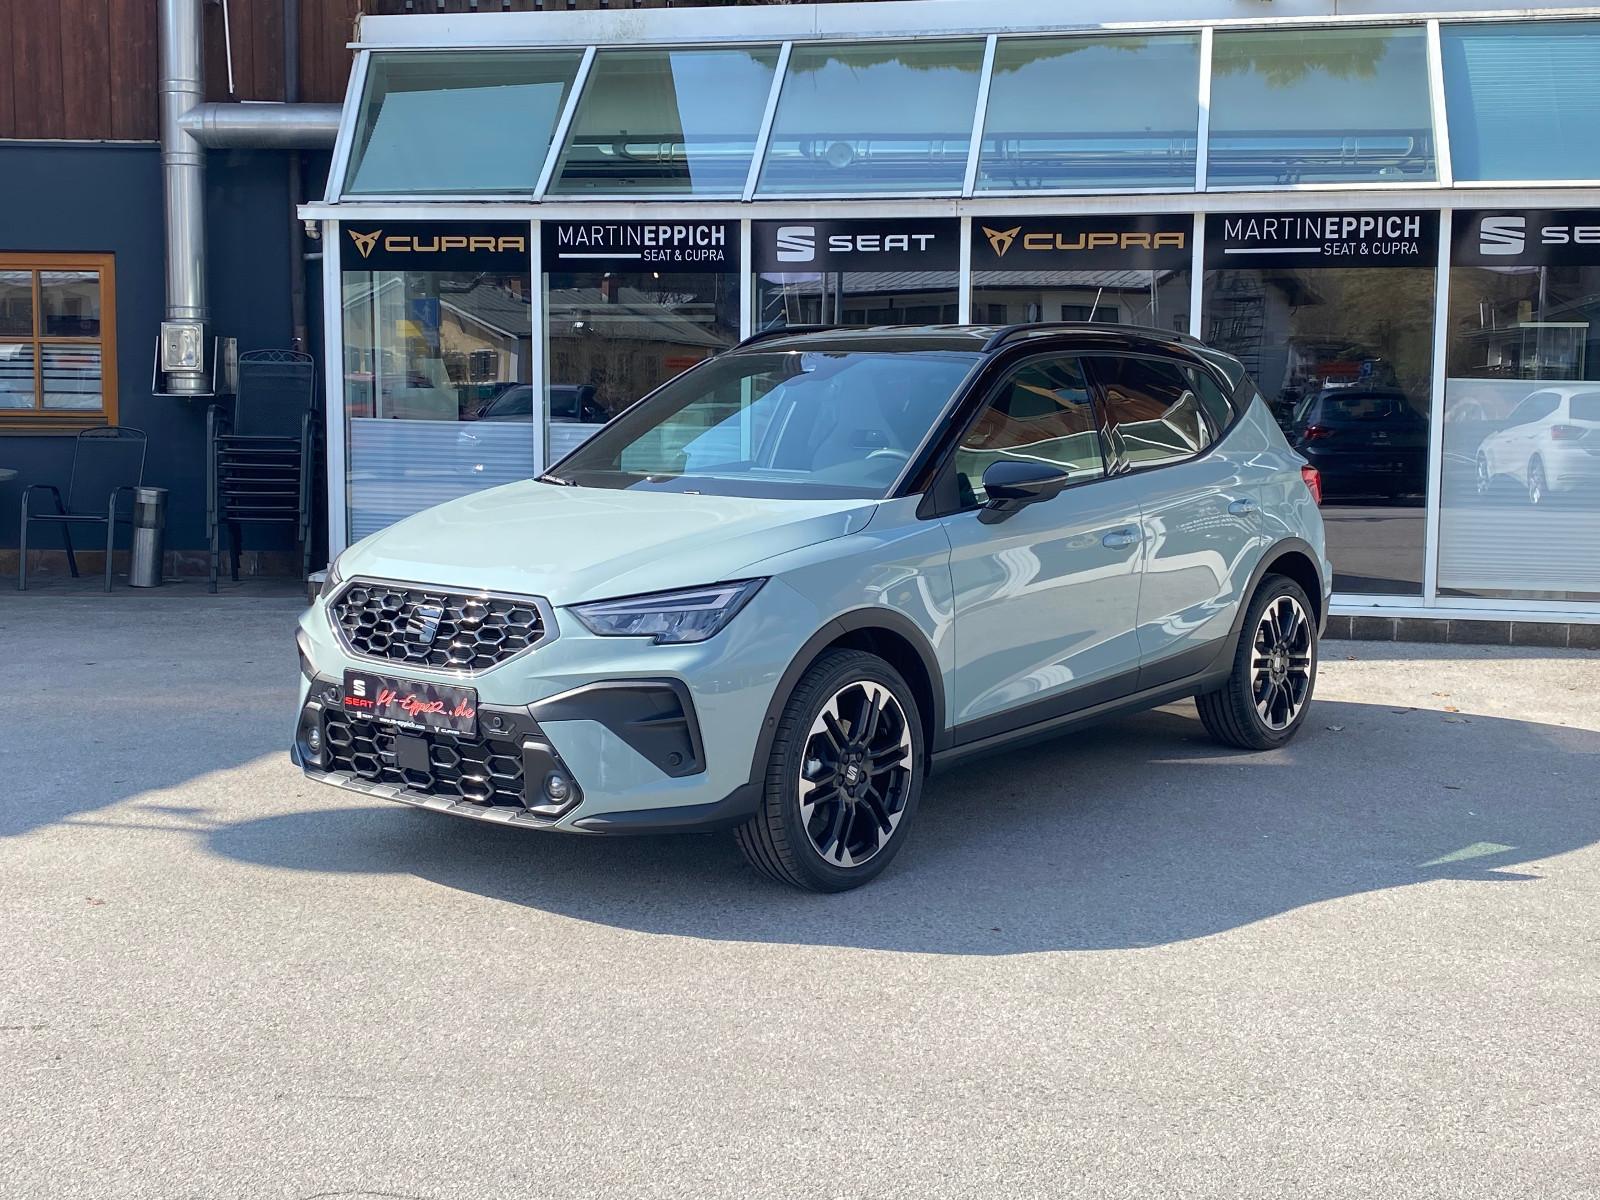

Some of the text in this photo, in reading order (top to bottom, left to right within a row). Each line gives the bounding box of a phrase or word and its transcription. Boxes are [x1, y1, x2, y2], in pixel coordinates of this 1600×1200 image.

[384, 235, 525, 253] CUPRA
[828, 234, 935, 252] SEAT
[1023, 232, 1185, 250] CUPRA
[1323, 241, 1419, 256] SEAT & CUPRA
[643, 250, 725, 261] SEAT & CUPRA
[344, 696, 374, 709] SEAT
